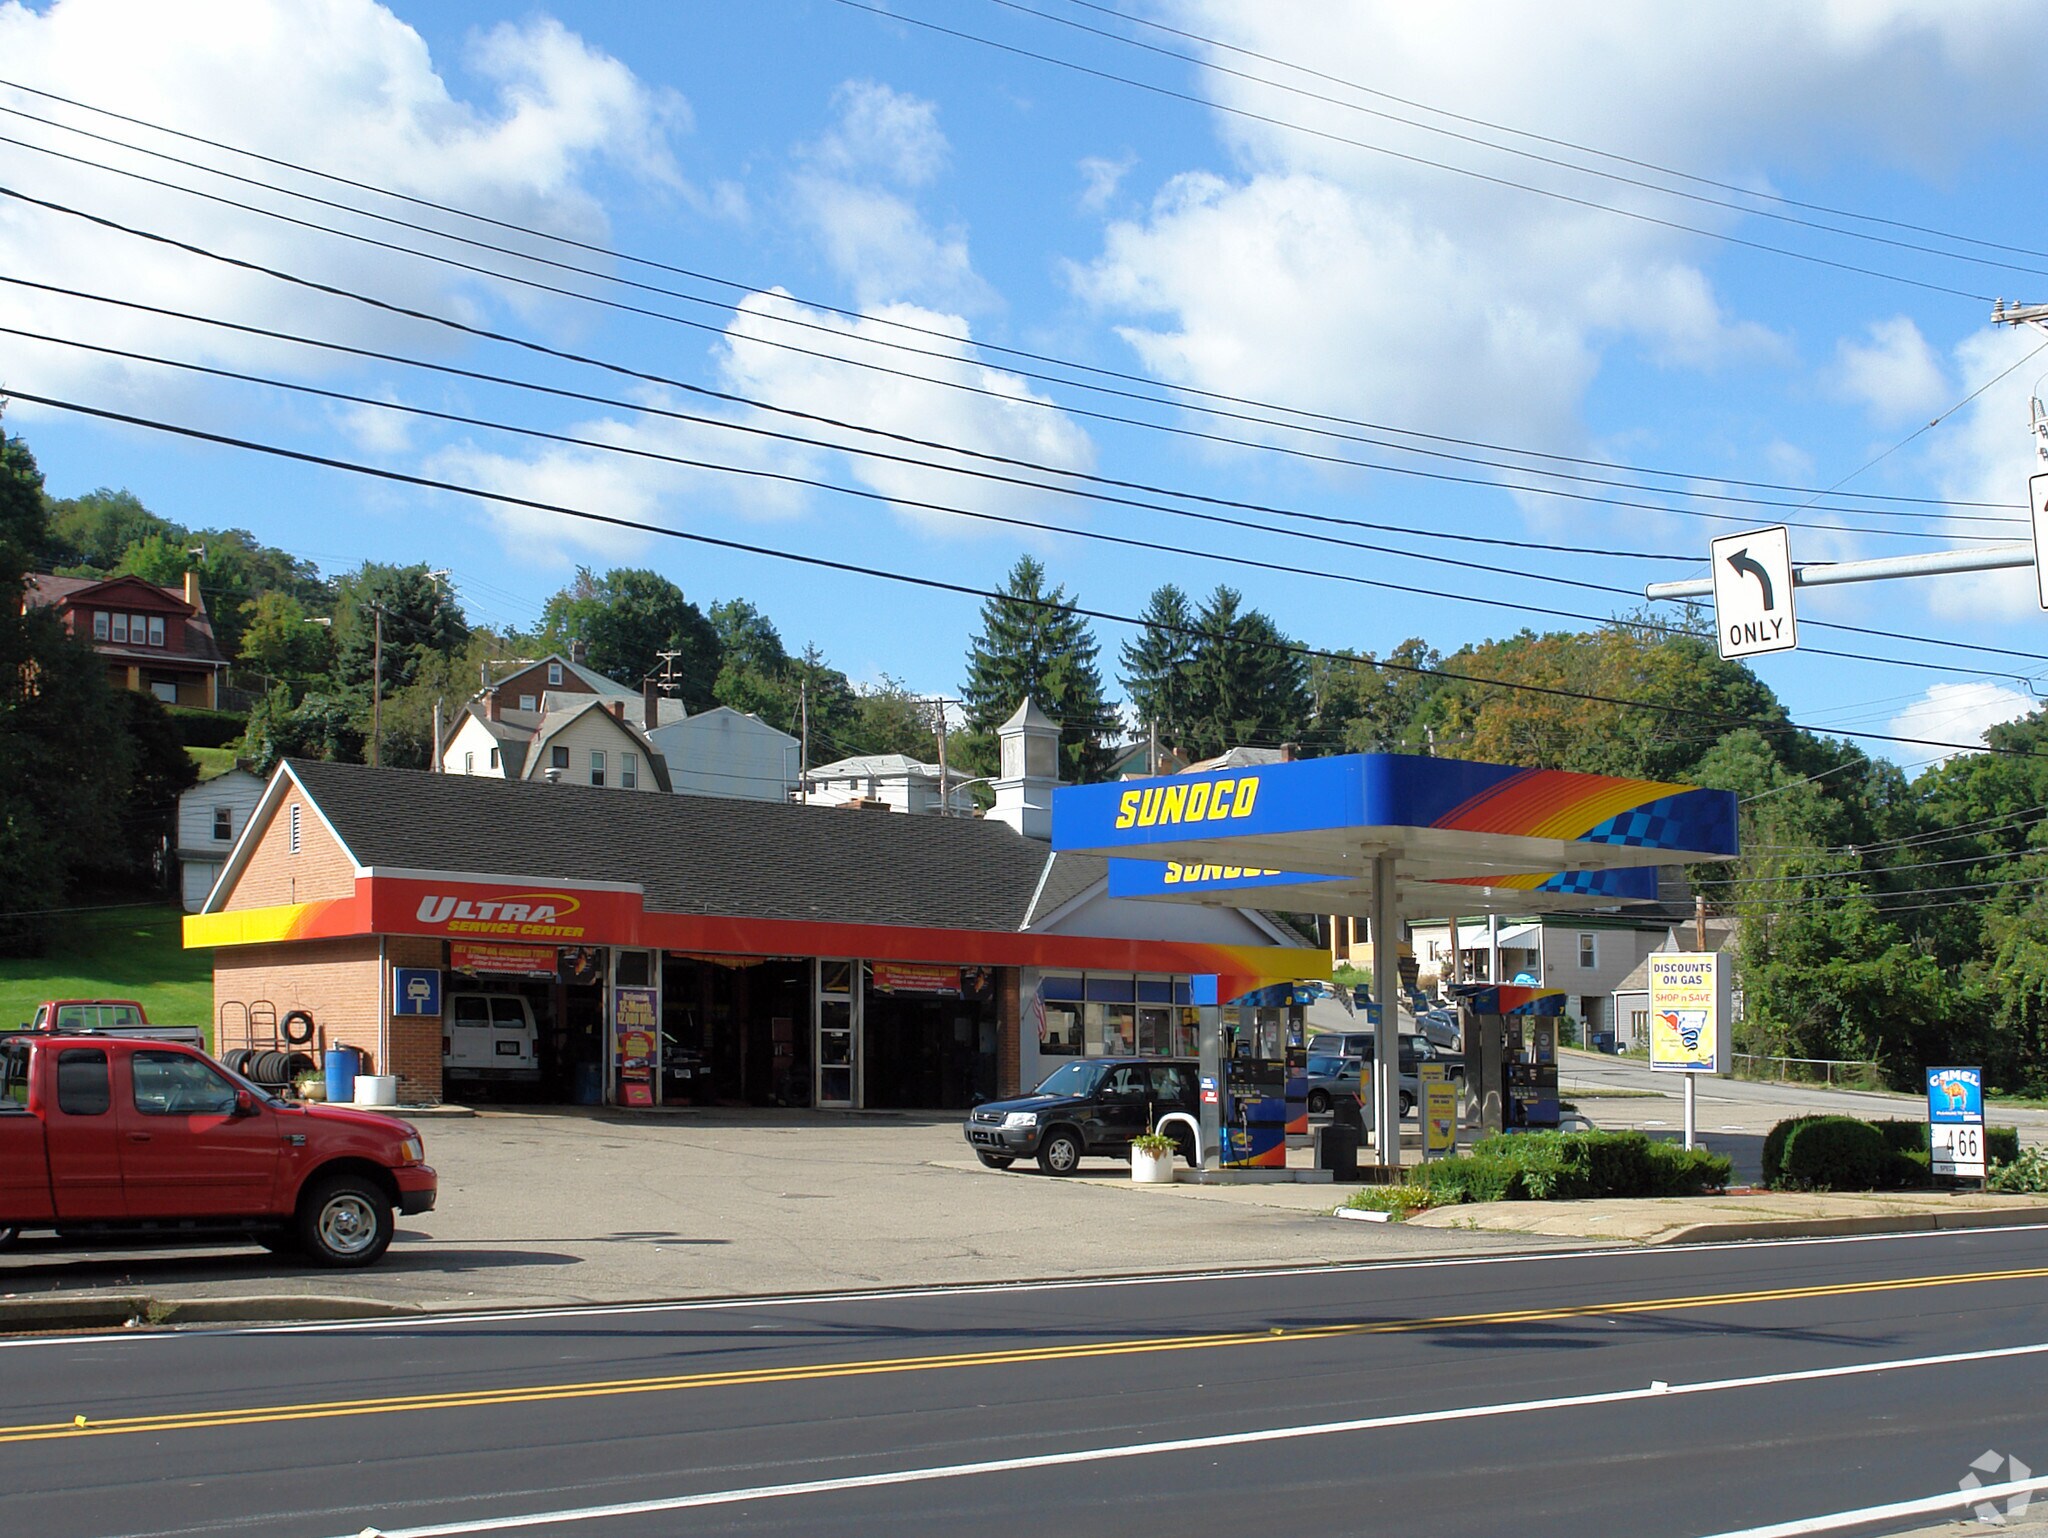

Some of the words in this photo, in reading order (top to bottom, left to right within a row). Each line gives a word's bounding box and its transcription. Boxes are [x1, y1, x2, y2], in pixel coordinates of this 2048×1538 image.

[1730, 617, 1783, 646] ONLY
[1115, 777, 1260, 829] SUNOCO
[416, 895, 556, 923] ULTRA
[447, 921, 517, 934] SERVICE
[520, 924, 585, 937] CENTER
[1654, 963, 1712, 973] DISCOUNTS
[1663, 975, 1677, 984] ON
[1681, 975, 1703, 985] GAS
[1655, 993, 1679, 1002] SHOP
[1689, 993, 1711, 1002] SAVE
[1560, 1006, 1565, 1014] 7
[1929, 1070, 1980, 1087] CAMEL
